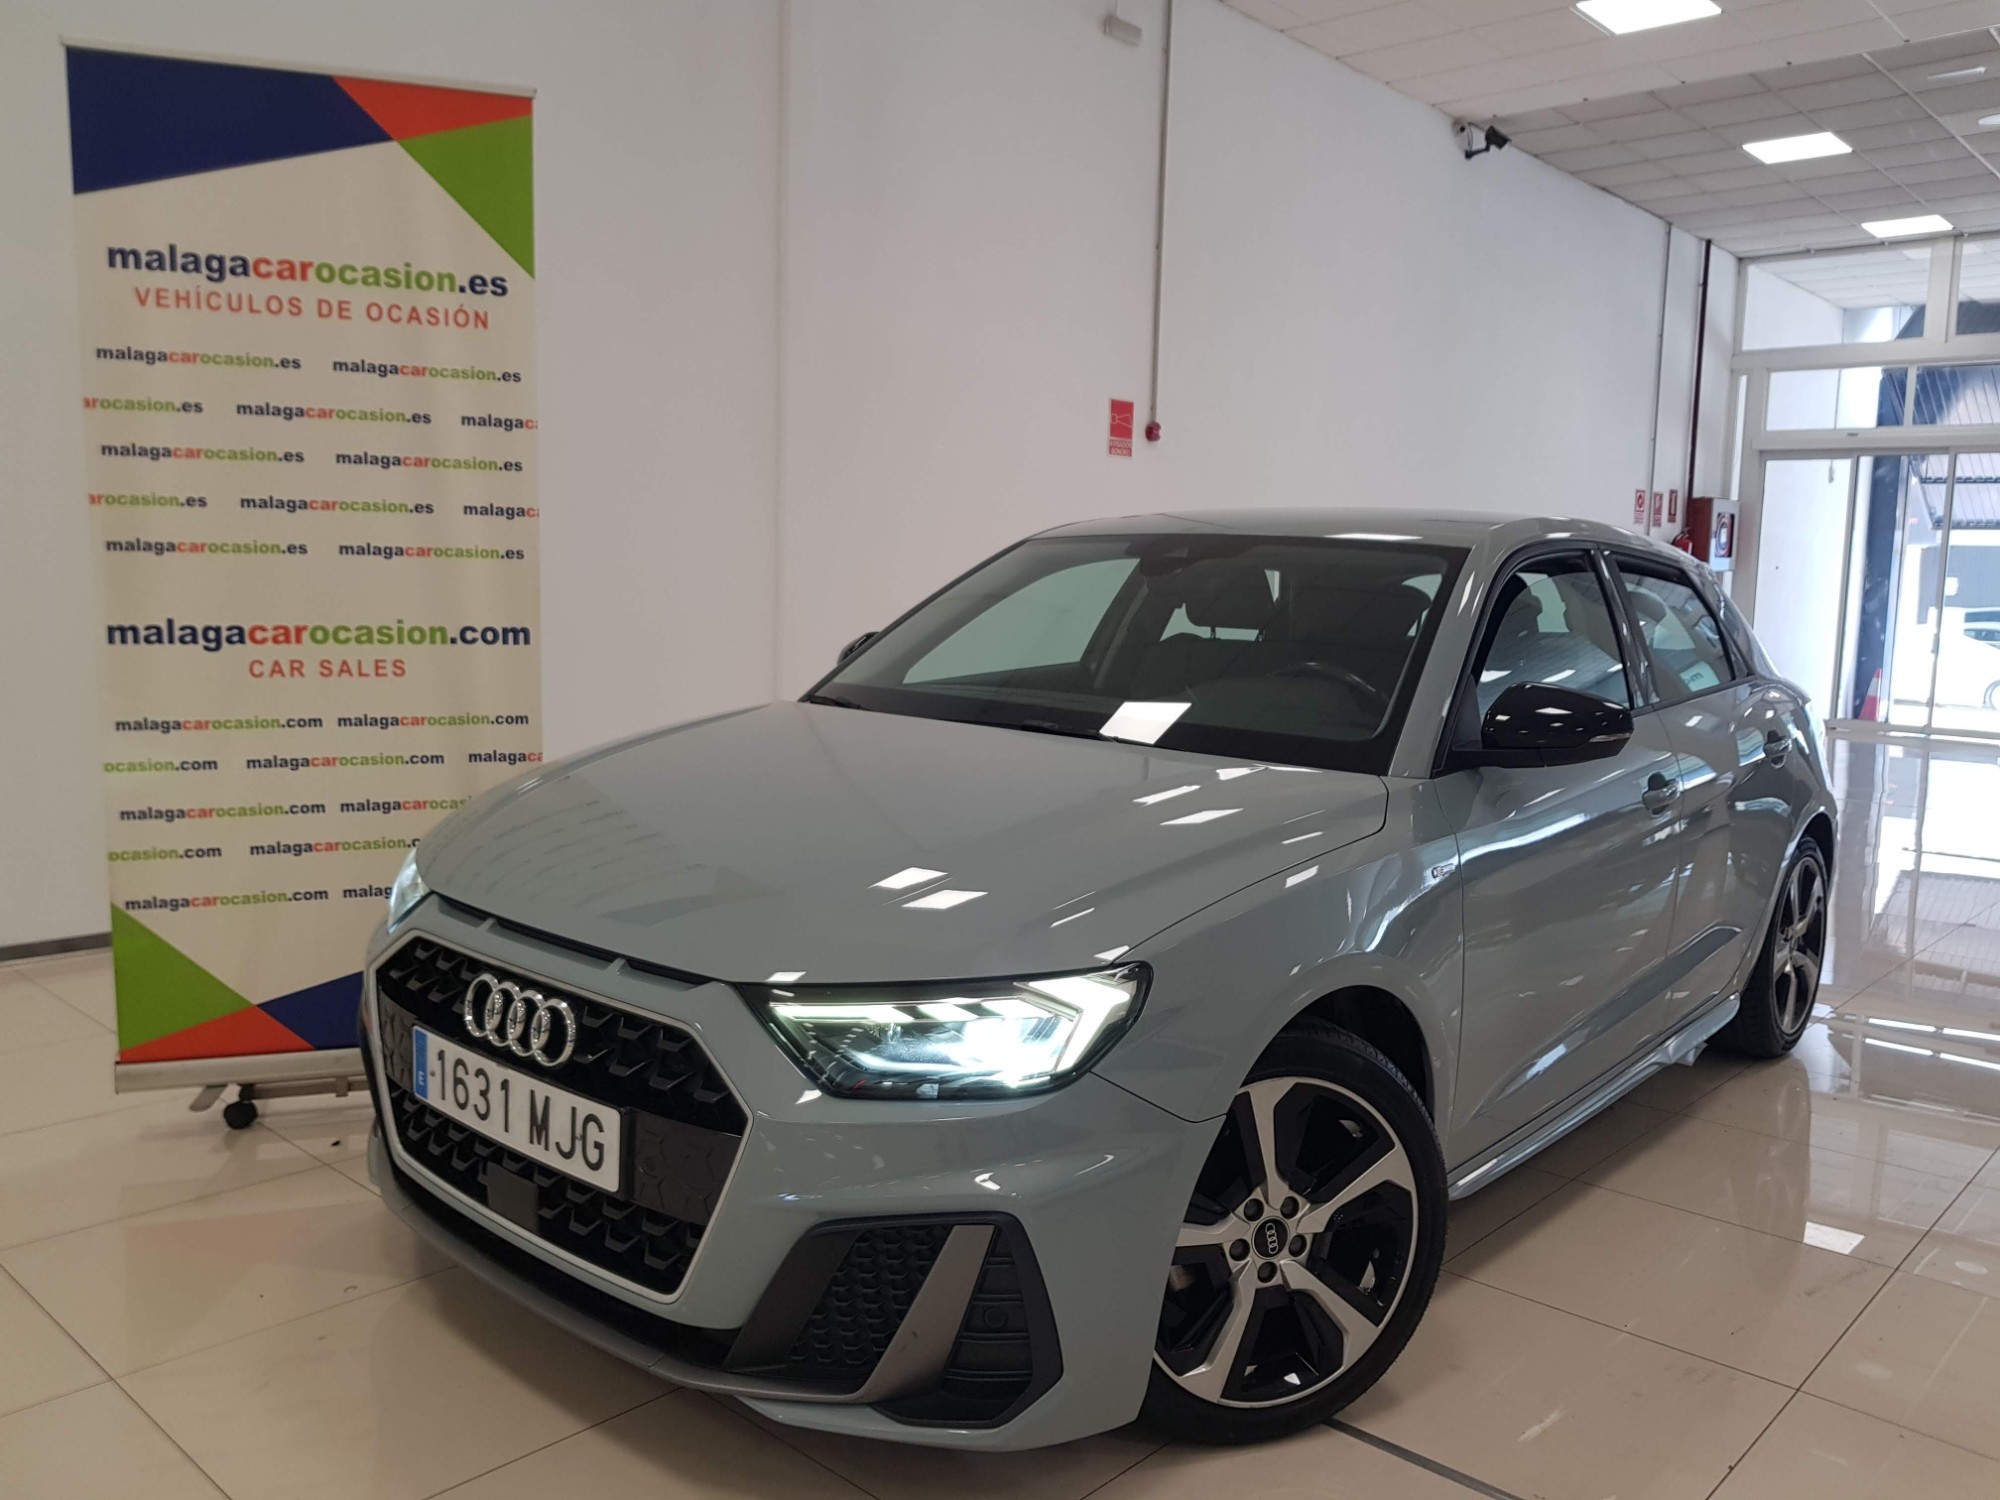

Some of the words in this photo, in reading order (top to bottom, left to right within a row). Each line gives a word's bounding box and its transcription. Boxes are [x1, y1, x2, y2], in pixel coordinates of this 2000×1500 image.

[107, 243, 509, 297] malagacarocasion.es
[135, 285, 305, 317] VEHÍCULOS
[317, 299, 352, 320] DE
[366, 302, 488, 330] OCASIÓN
[96, 346, 301, 370] malagacarocasion.es
[332, 359, 521, 383] malagacarocasion.es
[236, 402, 432, 424] malagacarocasion.es
[101, 443, 304, 463] malagacarocasion.es
[336, 451, 523, 472] malagacarocasion.es
[240, 495, 434, 514] malagacarocasion.es
[105, 538, 308, 556] malagacarocasion.es
[338, 542, 524, 560] malagacarocasion.es
[106, 618, 531, 653] malagacarocasion.com
[249, 659, 305, 678] CAR
[319, 659, 406, 678] SALES
[115, 716, 323, 734] malagacarocasion.com
[337, 712, 529, 730] malagacarocasion.com
[246, 753, 444, 771] malagacarocasion.com
[119, 804, 326, 823] malagacarocasion.com
[125, 889, 329, 911] malagacarocasion.com
[437, 1049, 510, 1133] 1631
[529, 1088, 605, 1172] MJG
